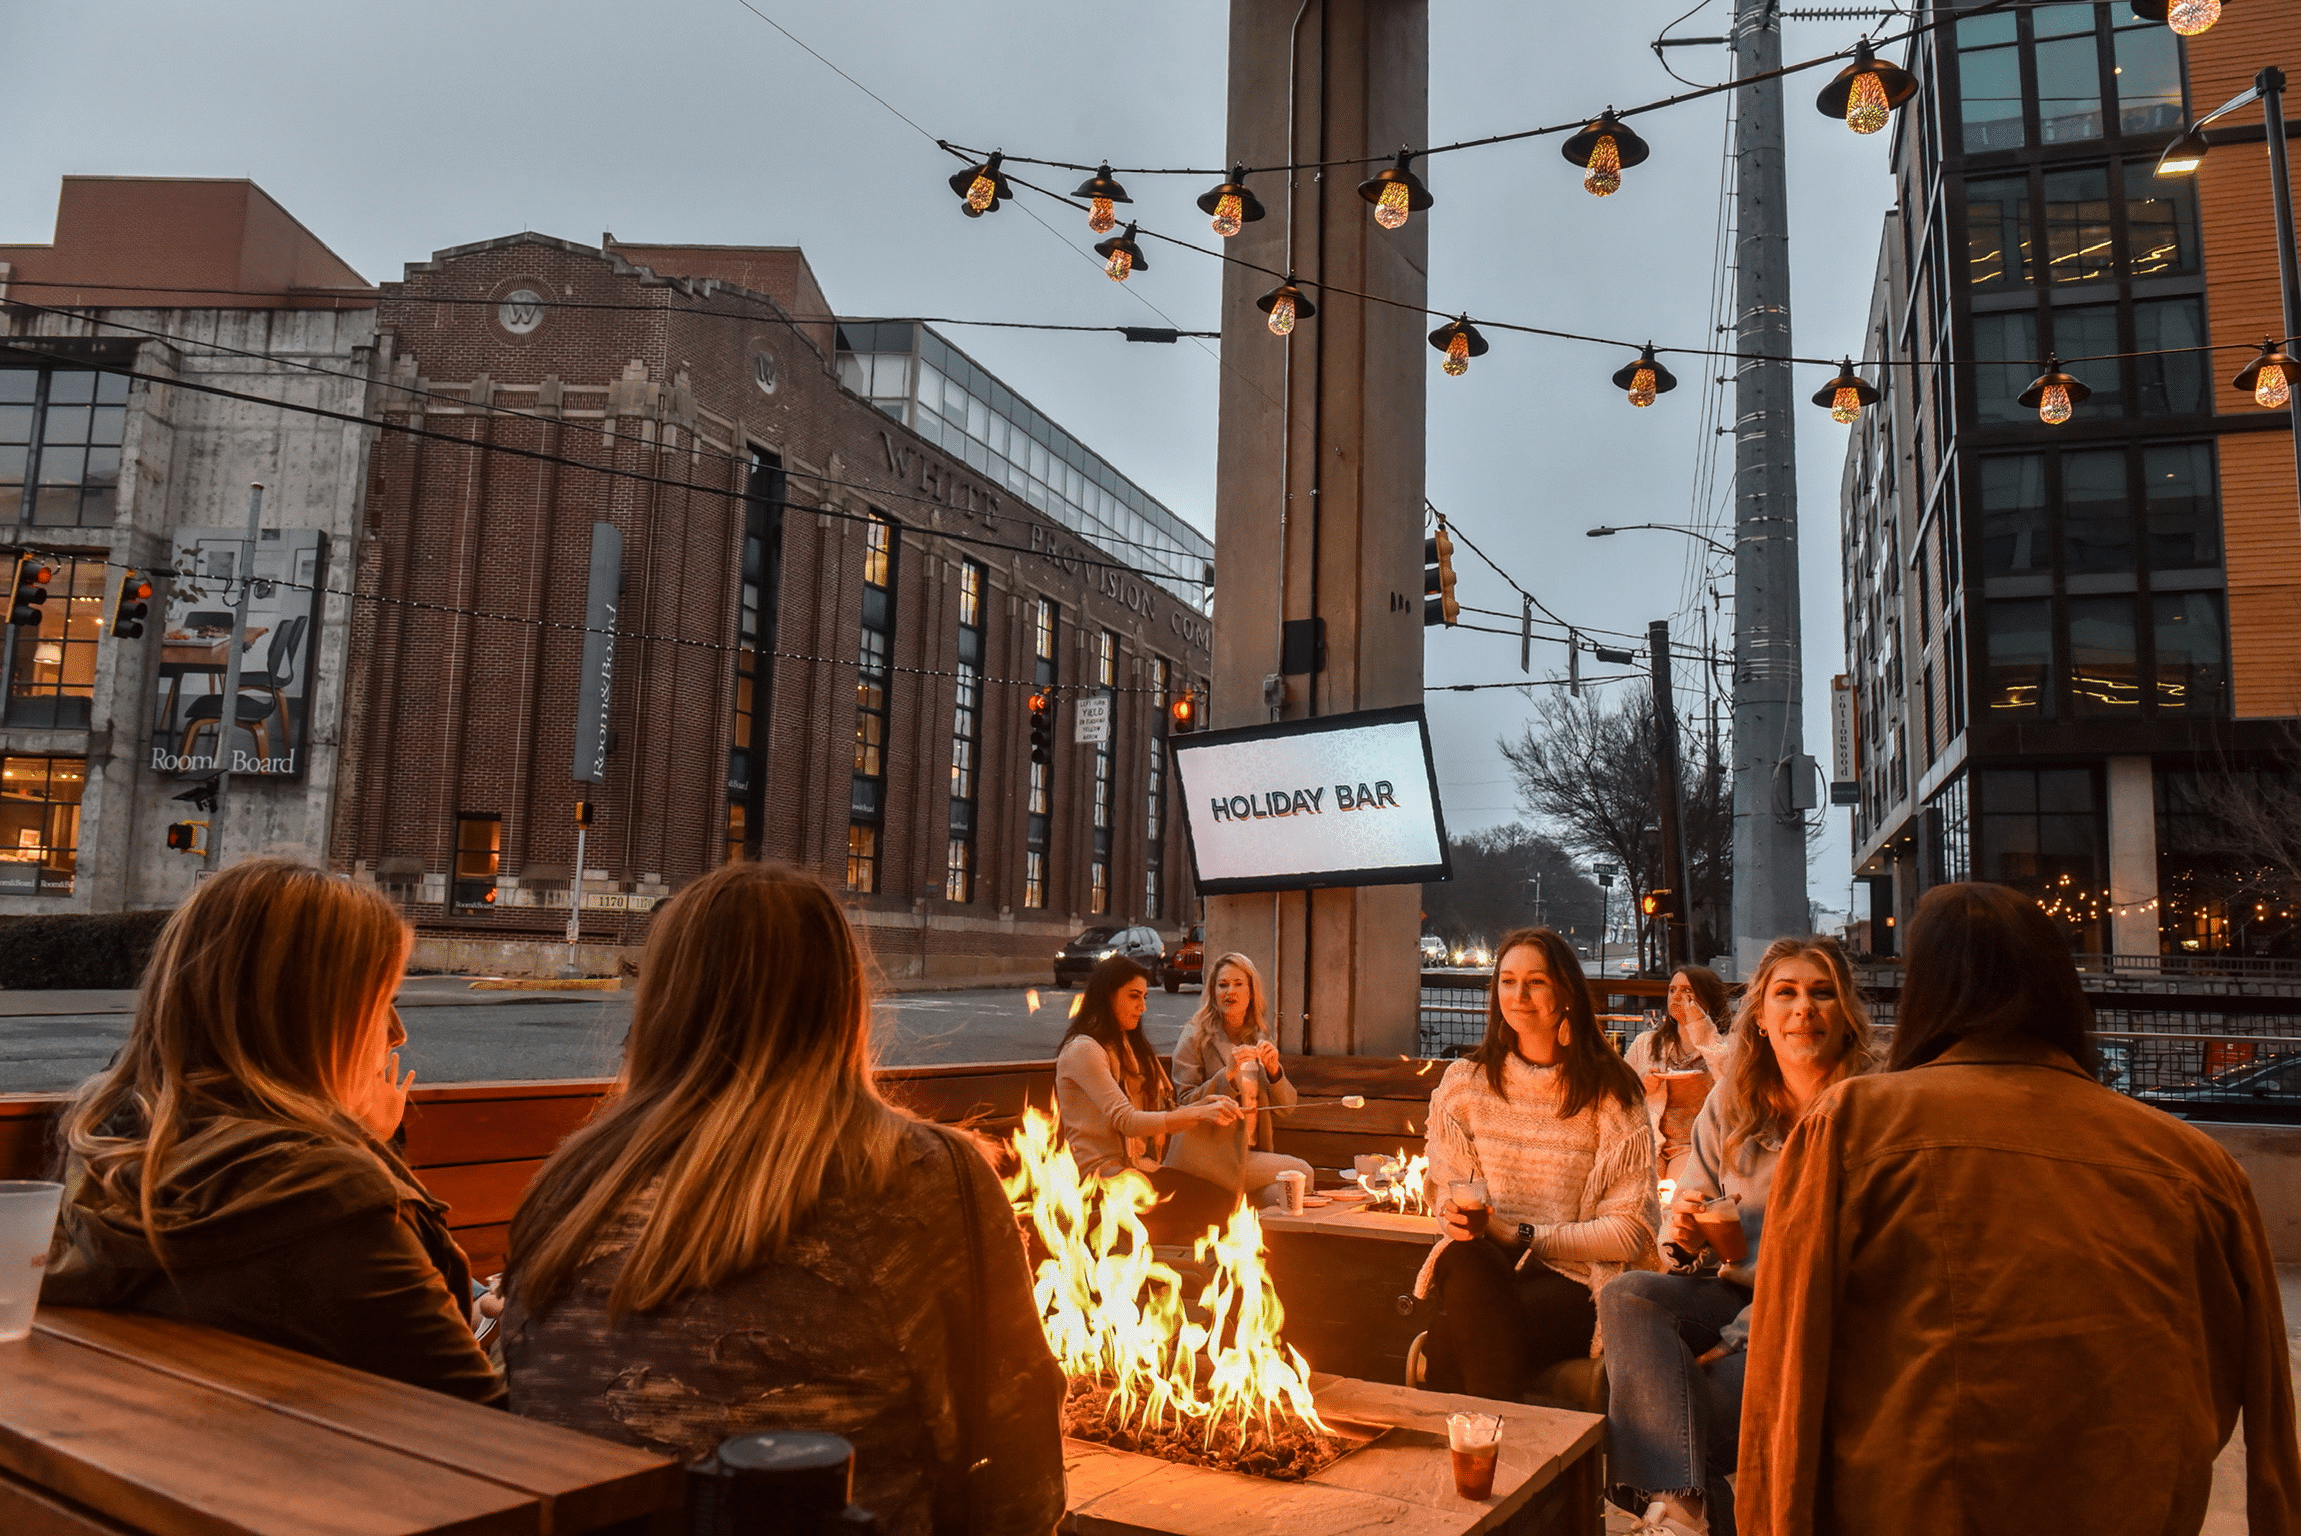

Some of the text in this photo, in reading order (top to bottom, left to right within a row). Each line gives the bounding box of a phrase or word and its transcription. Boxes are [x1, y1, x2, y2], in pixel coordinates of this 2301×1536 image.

[508, 302, 538, 325] W
[879, 430, 1000, 532] WHITE
[1031, 524, 1156, 621] PROVISION
[1082, 707, 1104, 717] YIELD
[1838, 694, 1849, 777] cottonwood
[150, 747, 295, 774] Room Board
[1211, 780, 1400, 823] HOLIDAY BAR
[600, 896, 624, 907] 1170
